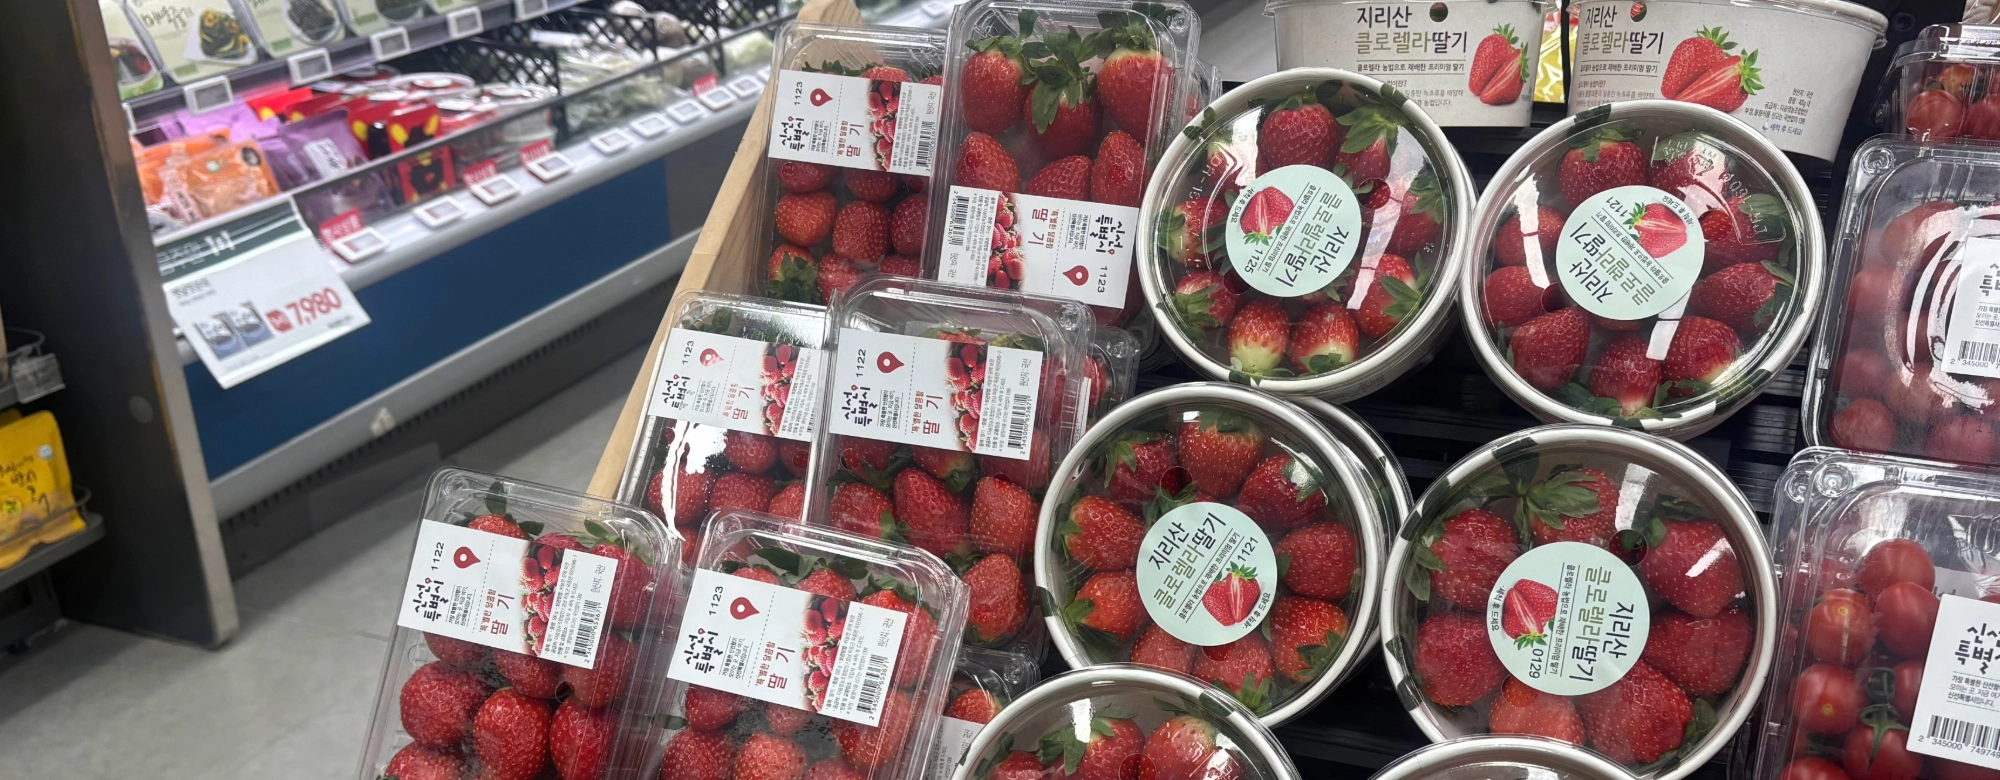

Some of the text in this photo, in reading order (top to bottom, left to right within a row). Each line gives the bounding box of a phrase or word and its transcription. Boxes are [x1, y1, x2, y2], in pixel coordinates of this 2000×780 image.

[1357, 5, 1412, 29] 지리산
[1585, 5, 1618, 29] 지리산
[1355, 30, 1468, 54] 클로렐라딸기
[1582, 31, 1664, 55] 클로렐라딸기
[793, 81, 802, 105] 1123
[779, 122, 793, 145] 신선
[789, 117, 809, 151] 특별시
[1605, 196, 1628, 217] 1121
[1089, 214, 1113, 252] 특별시
[1107, 221, 1124, 248] 신선
[1274, 191, 1342, 287] 클로렐라딸기
[1244, 249, 1263, 273] 1125
[1309, 226, 1349, 273] 지리산
[1570, 221, 1655, 305] 클로렐라딸기
[1097, 265, 1107, 293] 1123
[1568, 257, 1613, 303] 지리산
[286, 287, 342, 325] 7,980
[681, 340, 694, 364] 1123
[855, 348, 866, 377] 1122
[841, 391, 858, 419] 신선
[854, 386, 877, 426] 특별시
[430, 541, 444, 570] 1122
[1148, 521, 1189, 570] 지리산
[1153, 512, 1226, 608] 클로렐라딸기
[1237, 536, 1258, 565] 1121
[412, 583, 430, 613] 신선
[423, 579, 449, 621] 특별시
[708, 585, 723, 615] 1123
[1568, 566, 1611, 681] 클로렐라딸기
[1601, 601, 1634, 658] 지리산
[683, 634, 704, 664] 신선
[694, 630, 723, 673] 특별시
[1528, 645, 1543, 678] 0129
